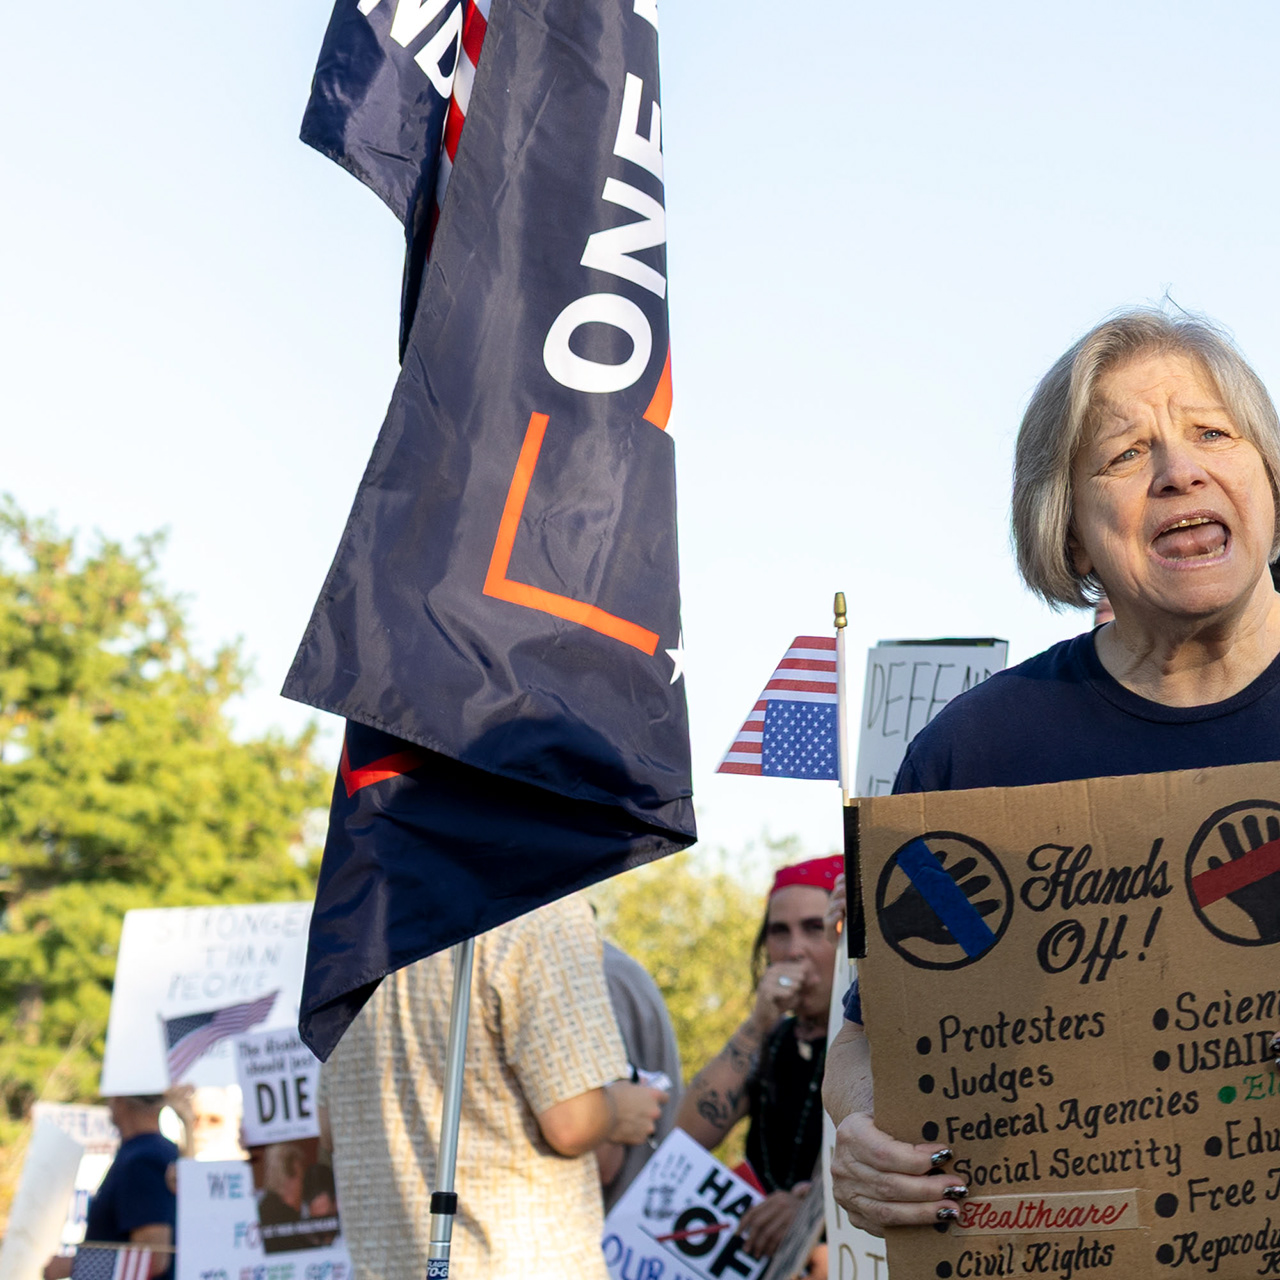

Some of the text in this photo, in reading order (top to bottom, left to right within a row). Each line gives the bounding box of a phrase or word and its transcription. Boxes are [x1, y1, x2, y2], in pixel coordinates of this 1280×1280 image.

[867, 661, 994, 741] DEFE
[1020, 837, 1174, 913] Hands
[1037, 906, 1163, 985] Off!
[938, 1006, 1106, 1053] Protesters
[256, 1076, 312, 1124] DIE
[942, 1063, 1054, 1103] Judges
[946, 1087, 1200, 1144] Federal Agencies
[953, 1138, 1182, 1187] Social Security
[697, 1167, 754, 1219] HA
[956, 1200, 1128, 1229] Healthcare
[1188, 1177, 1256, 1212] Free
[956, 1237, 1115, 1280] Civil Rights
